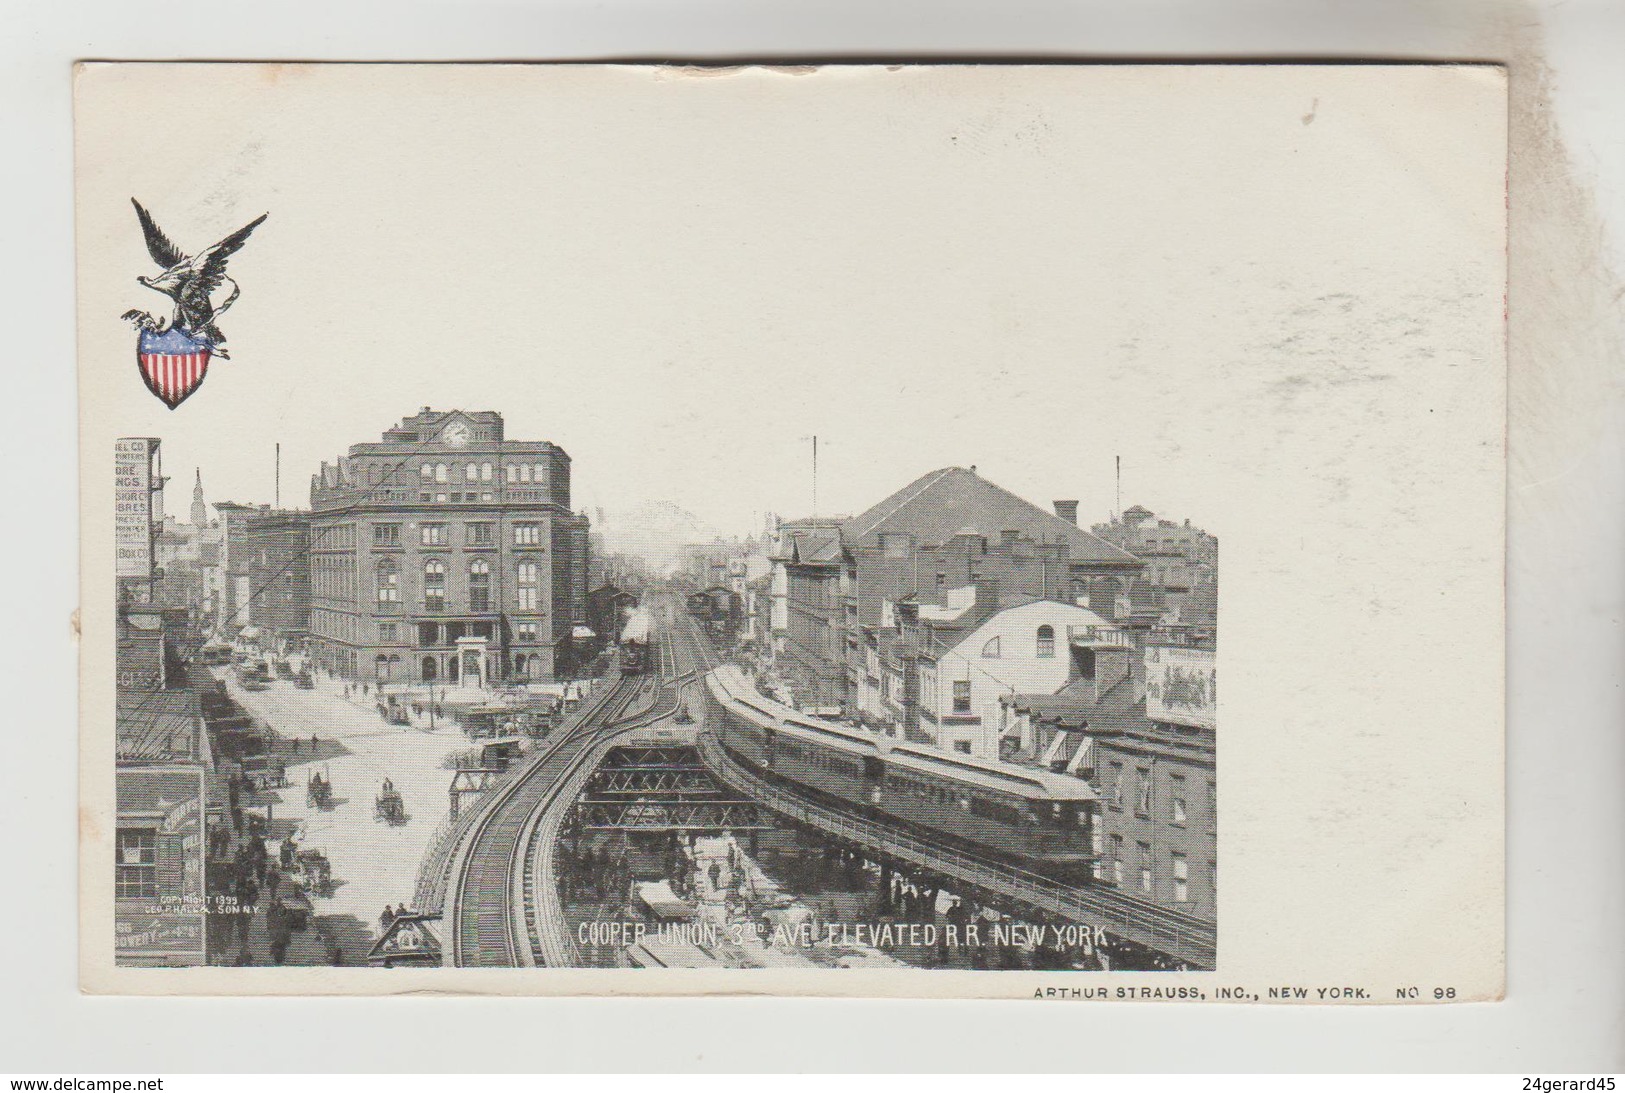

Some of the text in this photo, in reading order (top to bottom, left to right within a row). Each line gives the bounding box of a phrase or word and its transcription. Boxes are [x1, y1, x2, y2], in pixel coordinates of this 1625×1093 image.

[1034, 987, 1108, 998] ARTHUR
[1116, 986, 1206, 1000] STRAUSS,
[1215, 986, 1259, 1001] INC.,
[1268, 987, 1307, 999] NEW
[1317, 987, 1371, 999] YORK.
[1433, 987, 1456, 999] 98
